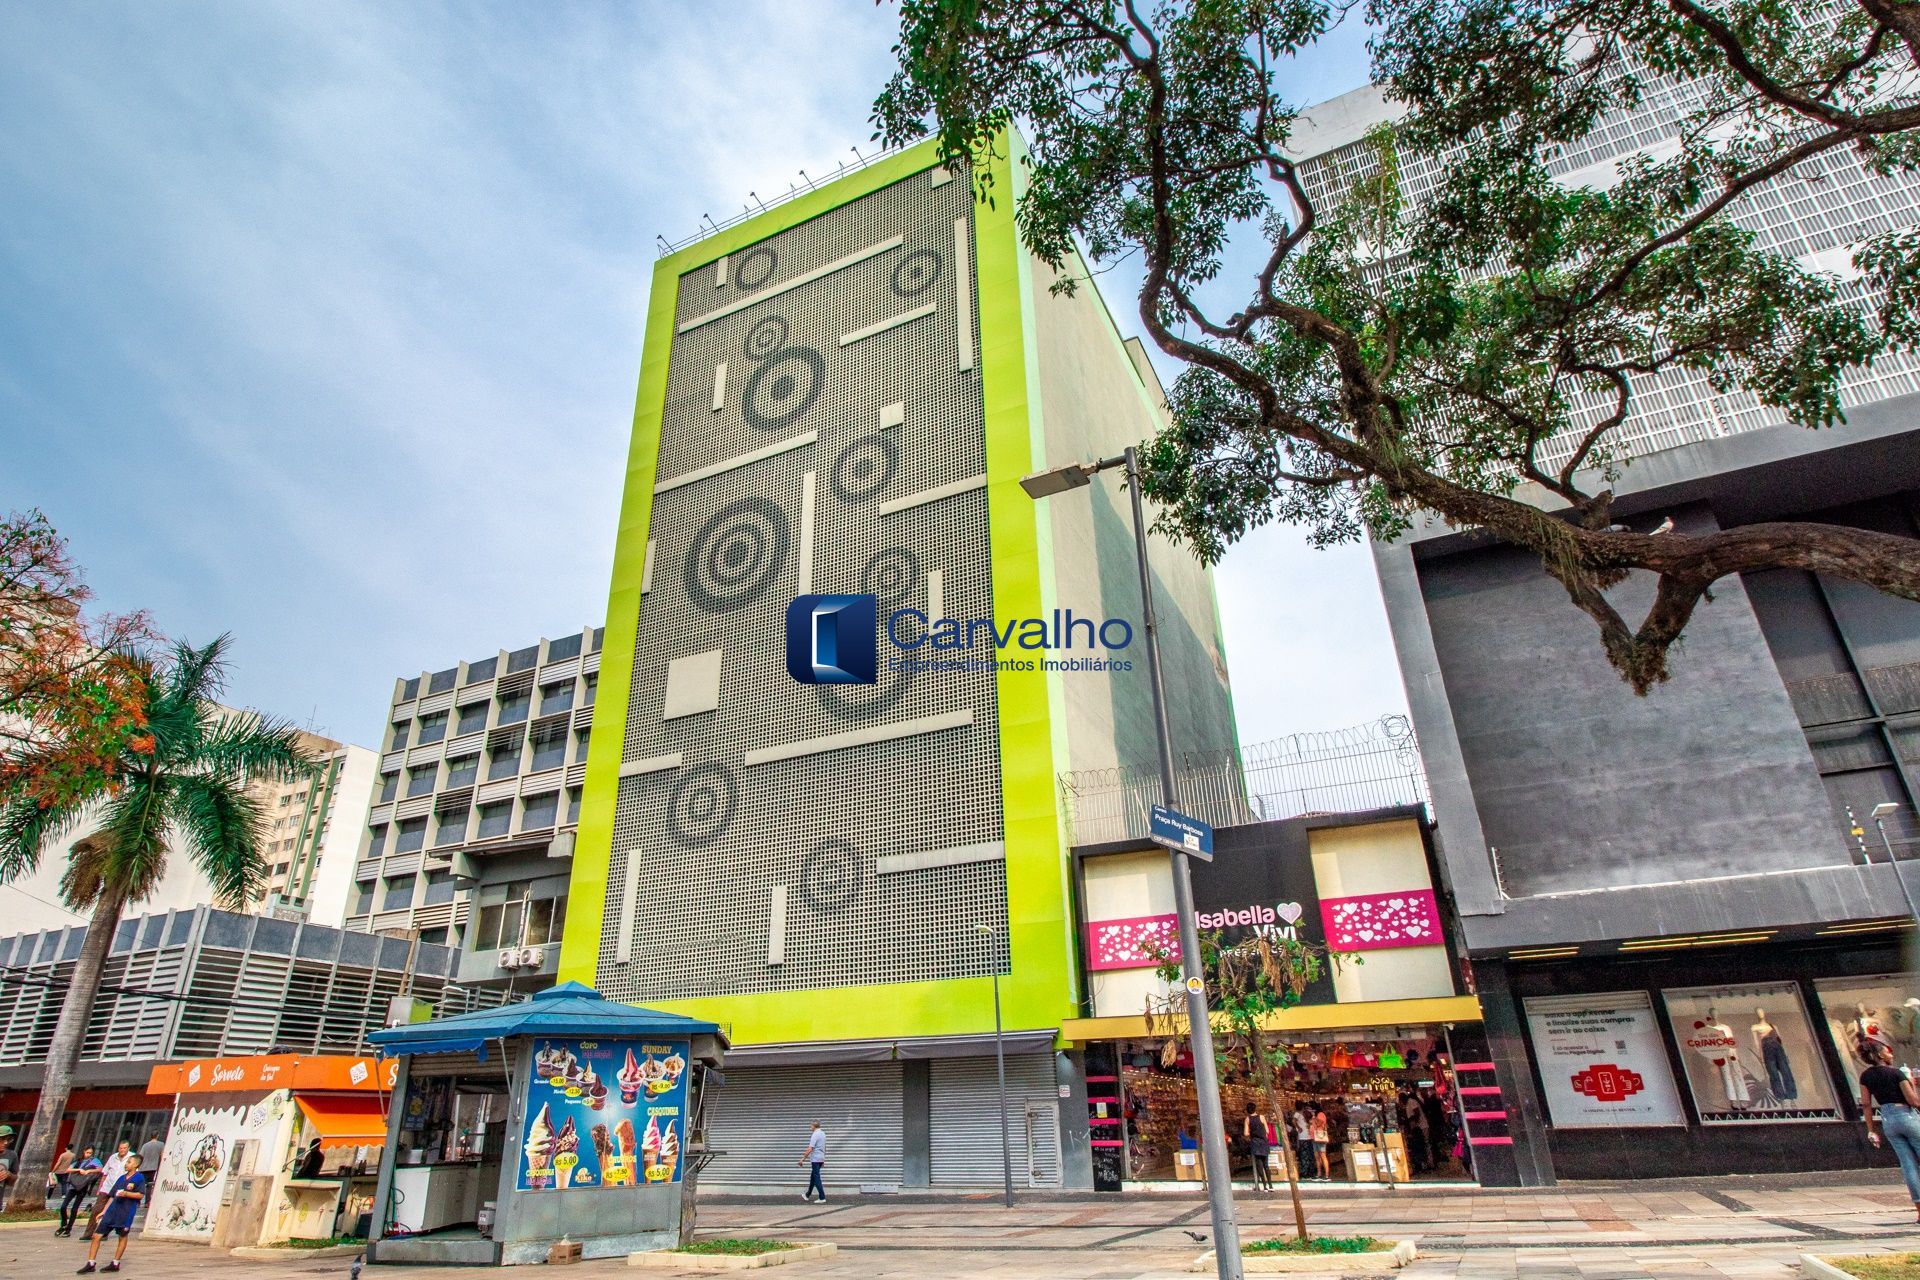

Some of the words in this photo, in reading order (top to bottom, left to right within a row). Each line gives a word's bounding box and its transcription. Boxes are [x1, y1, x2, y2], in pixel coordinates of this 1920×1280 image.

[1154, 813, 1171, 825] Praça
[1171, 819, 1182, 830] Ruy
[1182, 823, 1204, 837] Barbosa
[1194, 905, 1276, 929] Isabella
[1552, 1018, 1579, 1026] finalize
[1600, 1017, 1635, 1026] compras
[641, 1045, 672, 1055] SUNDAY
[1687, 1037, 1736, 1048] CRIANÇAS
[211, 1063, 245, 1086] Sorvete
[177, 1117, 207, 1136] Sorvetes
